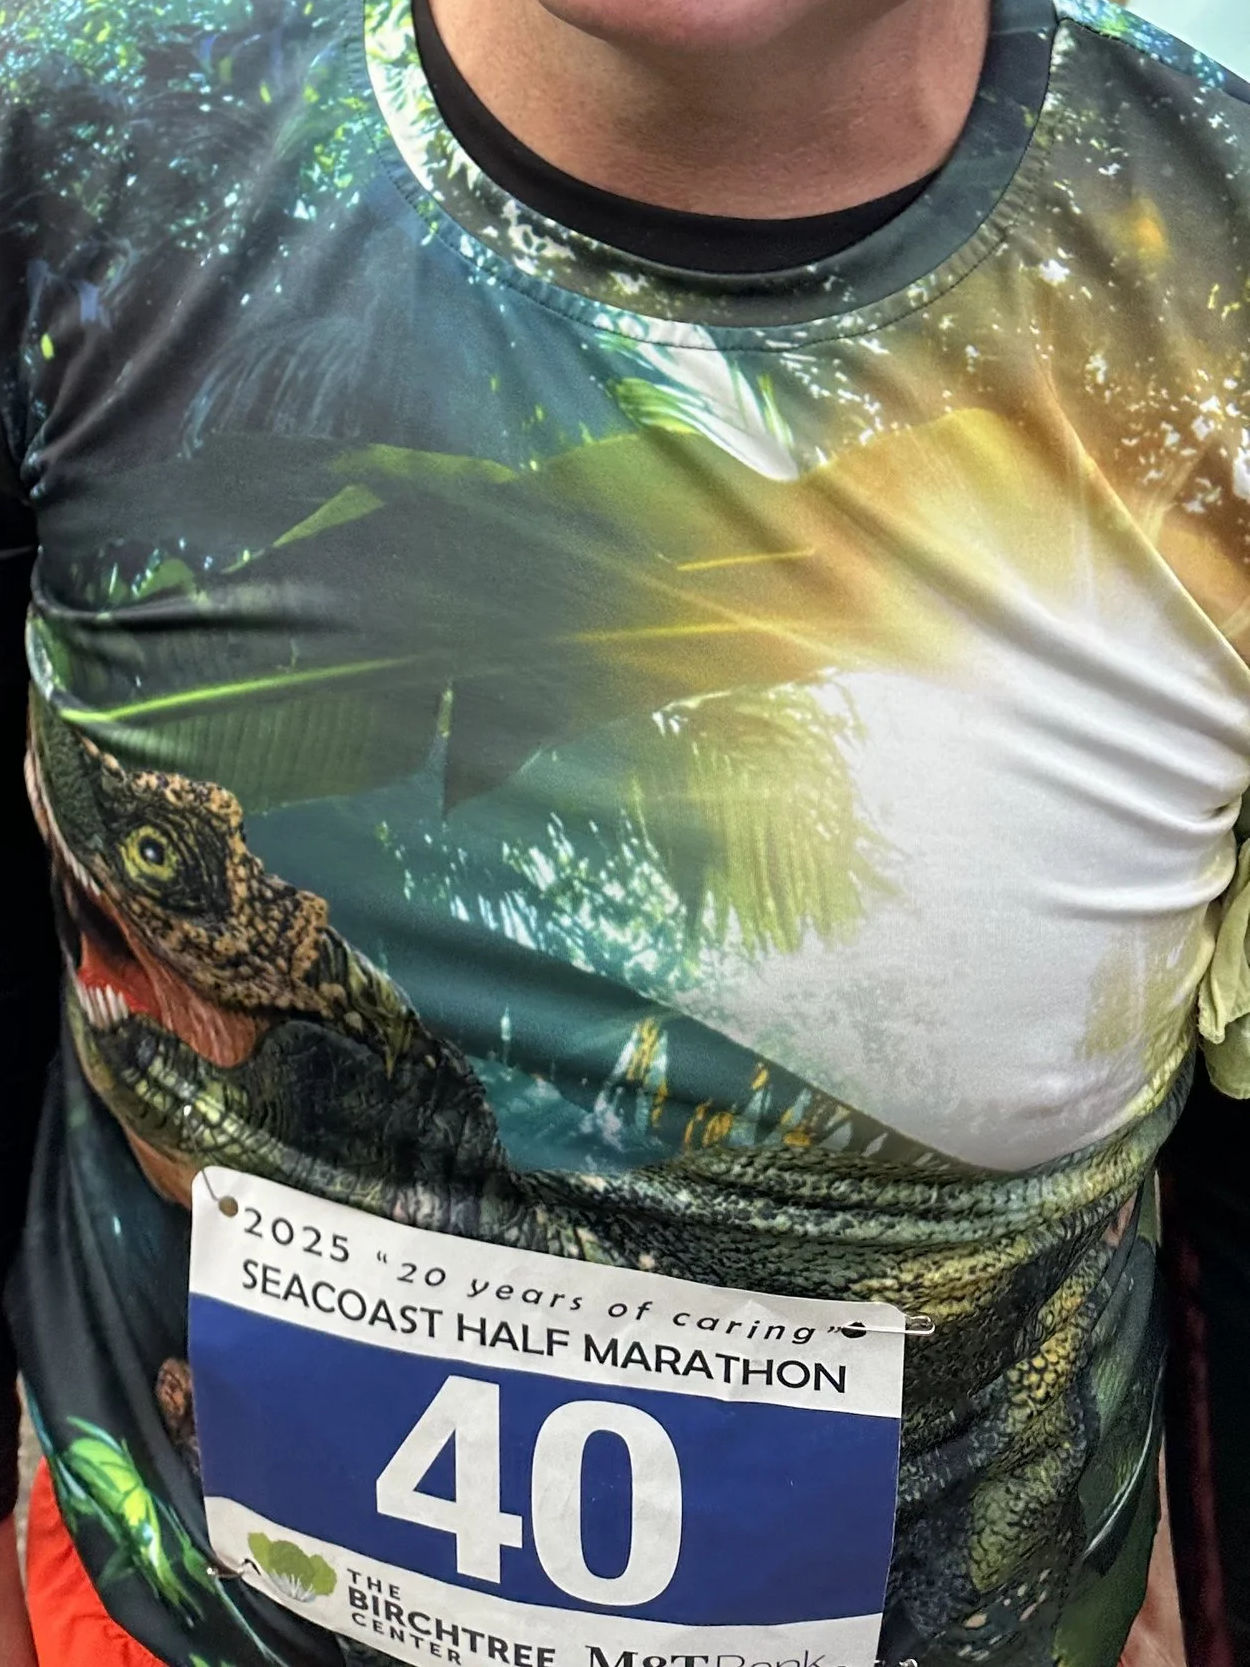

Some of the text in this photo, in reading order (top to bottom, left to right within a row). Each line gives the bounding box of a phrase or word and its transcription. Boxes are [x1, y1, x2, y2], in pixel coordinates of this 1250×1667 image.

[244, 1207, 350, 1263] 2025
[467, 1278, 581, 1311] years
[608, 1300, 653, 1321] of
[242, 1258, 847, 1394] SEACOAST HALF MARATHON
[375, 1375, 682, 1606] 40
[347, 1568, 400, 1602] THE
[348, 1585, 556, 1667] BIRCHTREE
[351, 1612, 462, 1666] CENTER
